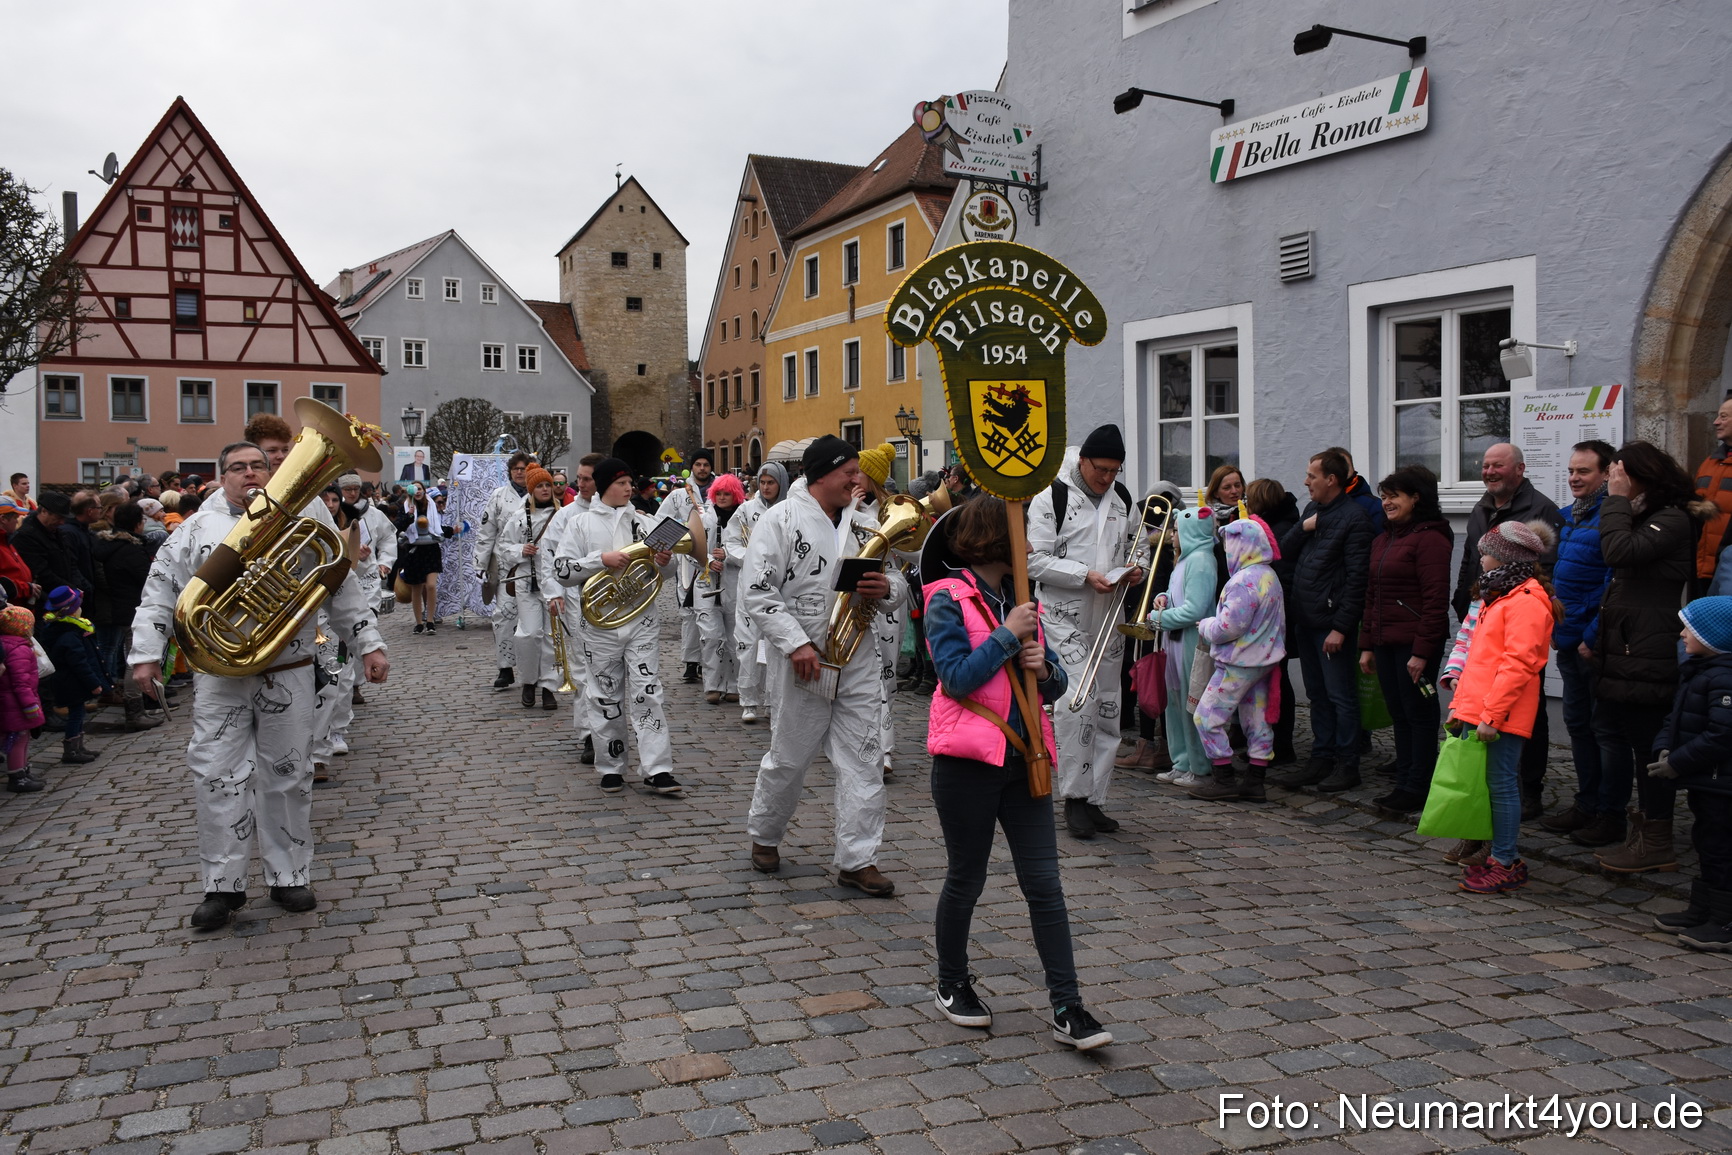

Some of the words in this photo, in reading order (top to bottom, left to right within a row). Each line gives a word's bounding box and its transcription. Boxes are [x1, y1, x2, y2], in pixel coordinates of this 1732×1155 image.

[965, 93, 1012, 111] Pizzeria
[1250, 116, 1290, 133] Pizzeria
[1301, 105, 1326, 119] Café
[1337, 87, 1382, 109] Eisdiele
[977, 113, 1001, 126] Café
[964, 127, 1012, 145] Eisdiele
[1242, 132, 1301, 168] Bella
[1308, 116, 1383, 151] Roma
[949, 161, 986, 173] Roma
[972, 156, 1006, 168] Bella
[892, 252, 1093, 337] Blaskapelle
[935, 300, 1061, 355] Pilsach
[981, 344, 1028, 365] 1954
[1523, 403, 1558, 413] Bella
[1536, 412, 1574, 421] Roma
[457, 460, 468, 475] 2
